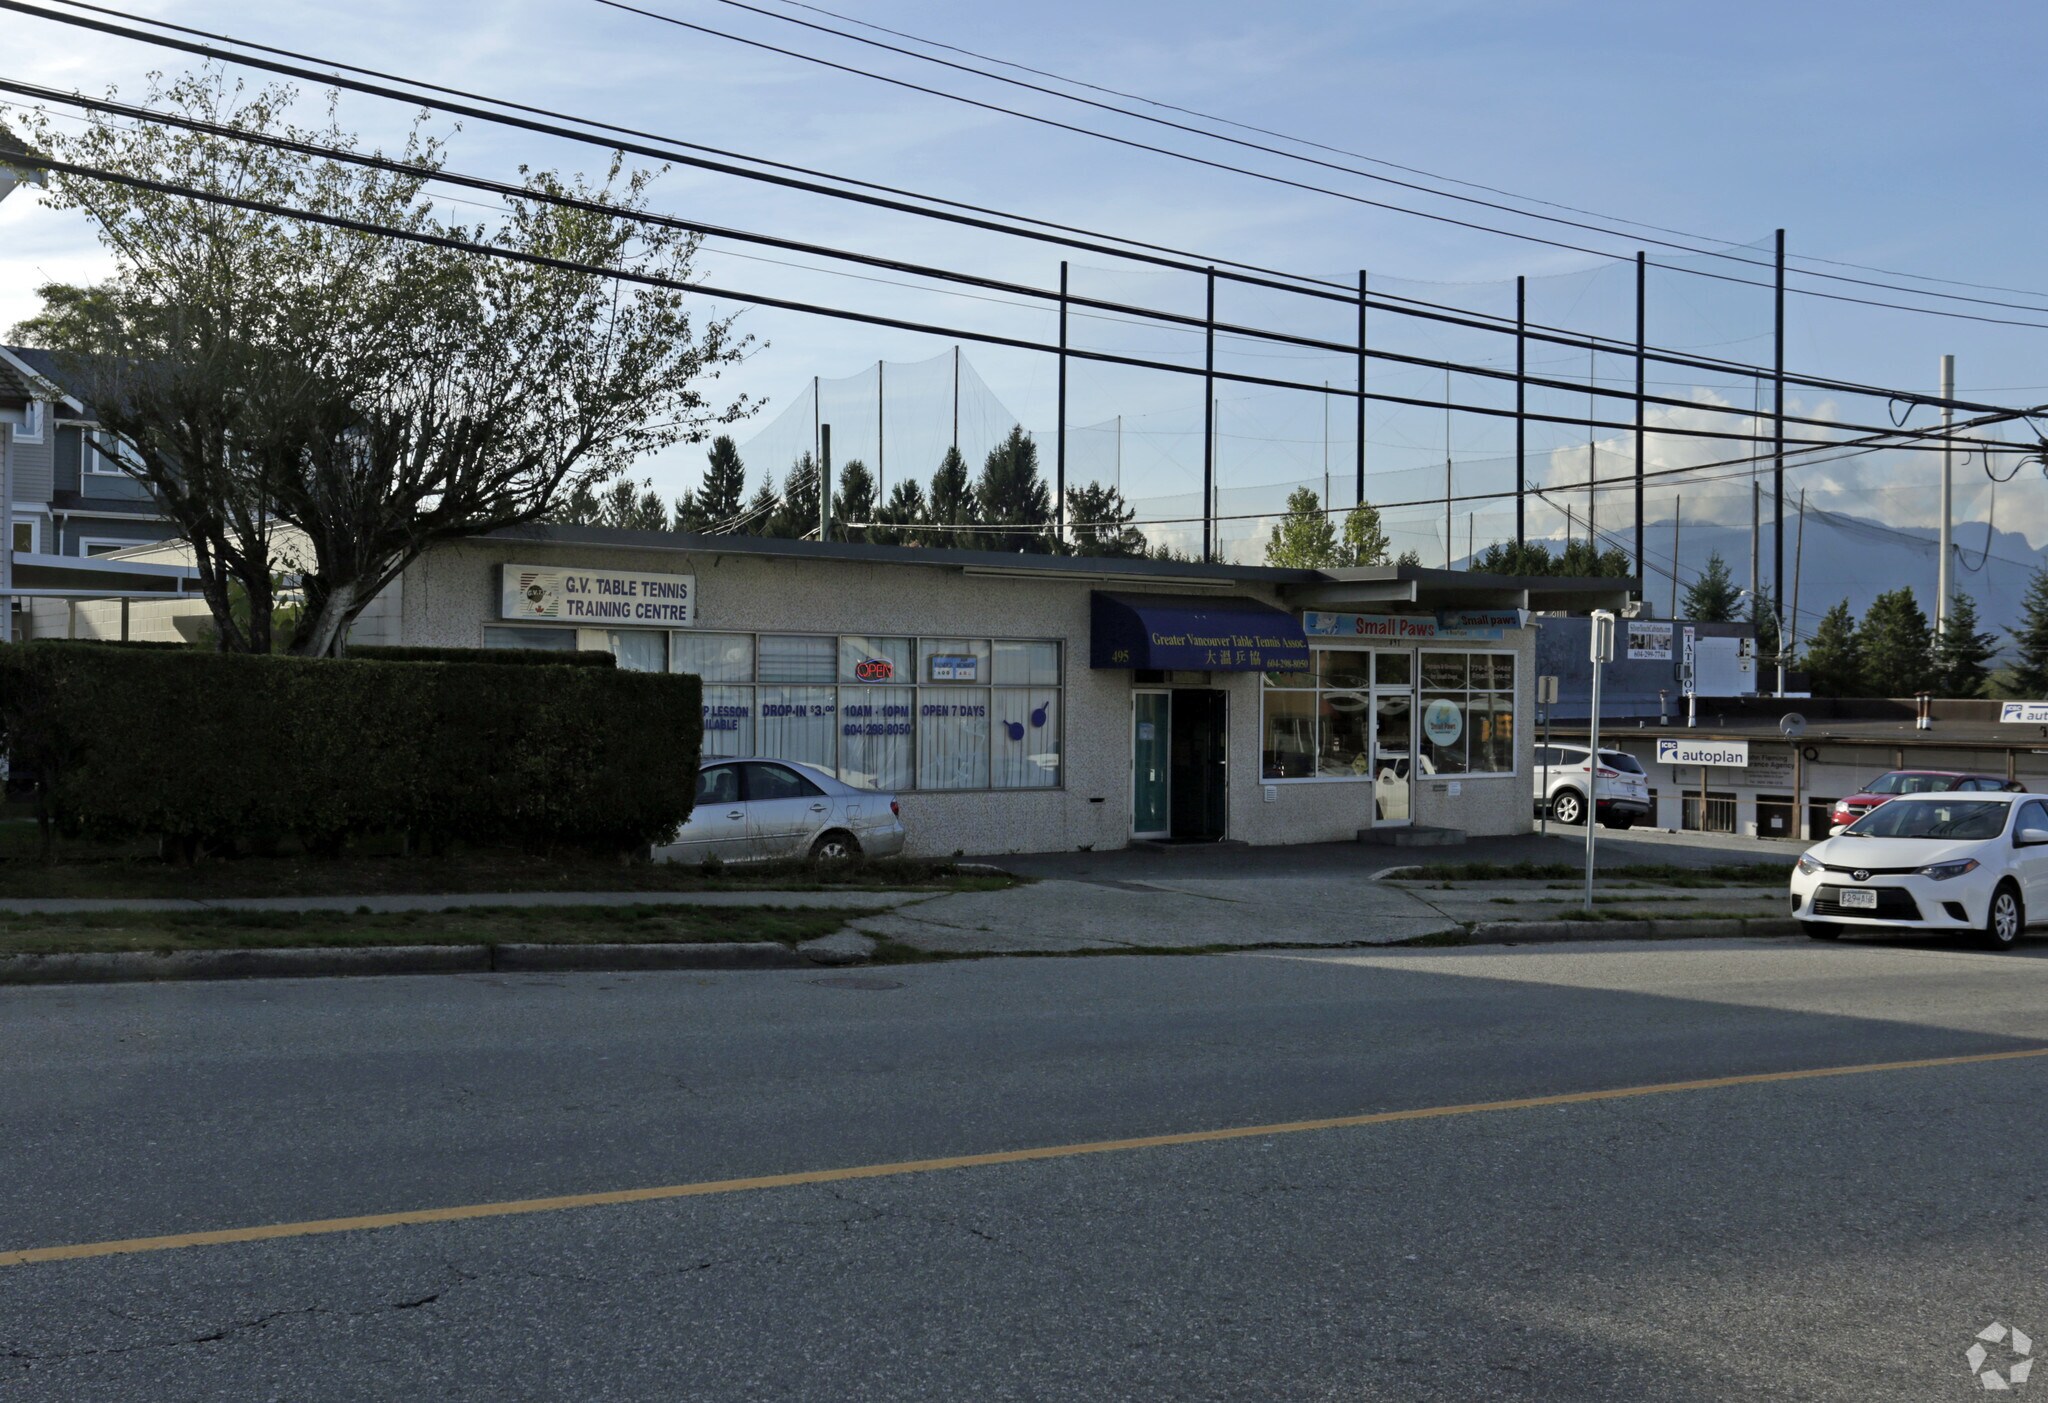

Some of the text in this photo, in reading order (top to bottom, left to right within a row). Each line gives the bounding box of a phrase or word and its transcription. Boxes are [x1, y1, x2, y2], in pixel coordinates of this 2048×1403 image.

[565, 576, 688, 599] G.V. TABLE TENNIS
[566, 599, 687, 621] TRAINING CENTRE
[1355, 616, 1434, 636] Small Paws
[1461, 615, 1516, 627] Small paws
[1151, 632, 1306, 649] Greater Vancouver Table Tennis Assoc.
[1112, 650, 1129, 663] 495
[857, 663, 893, 678] OPEN
[712, 705, 749, 718] LESSON
[762, 704, 807, 717] DROP-IN
[844, 705, 872, 717] 10AM
[881, 705, 909, 717] 10PM
[922, 704, 985, 717] OPEN 7 DAYS
[704, 719, 738, 731] ILABLE
[843, 723, 911, 736] 604-298-8050
[1661, 741, 1677, 749] ICBC
[1682, 750, 1743, 765] autoplan
[1761, 754, 1788, 763] Fleming
[1770, 762, 1795, 770] Agency
